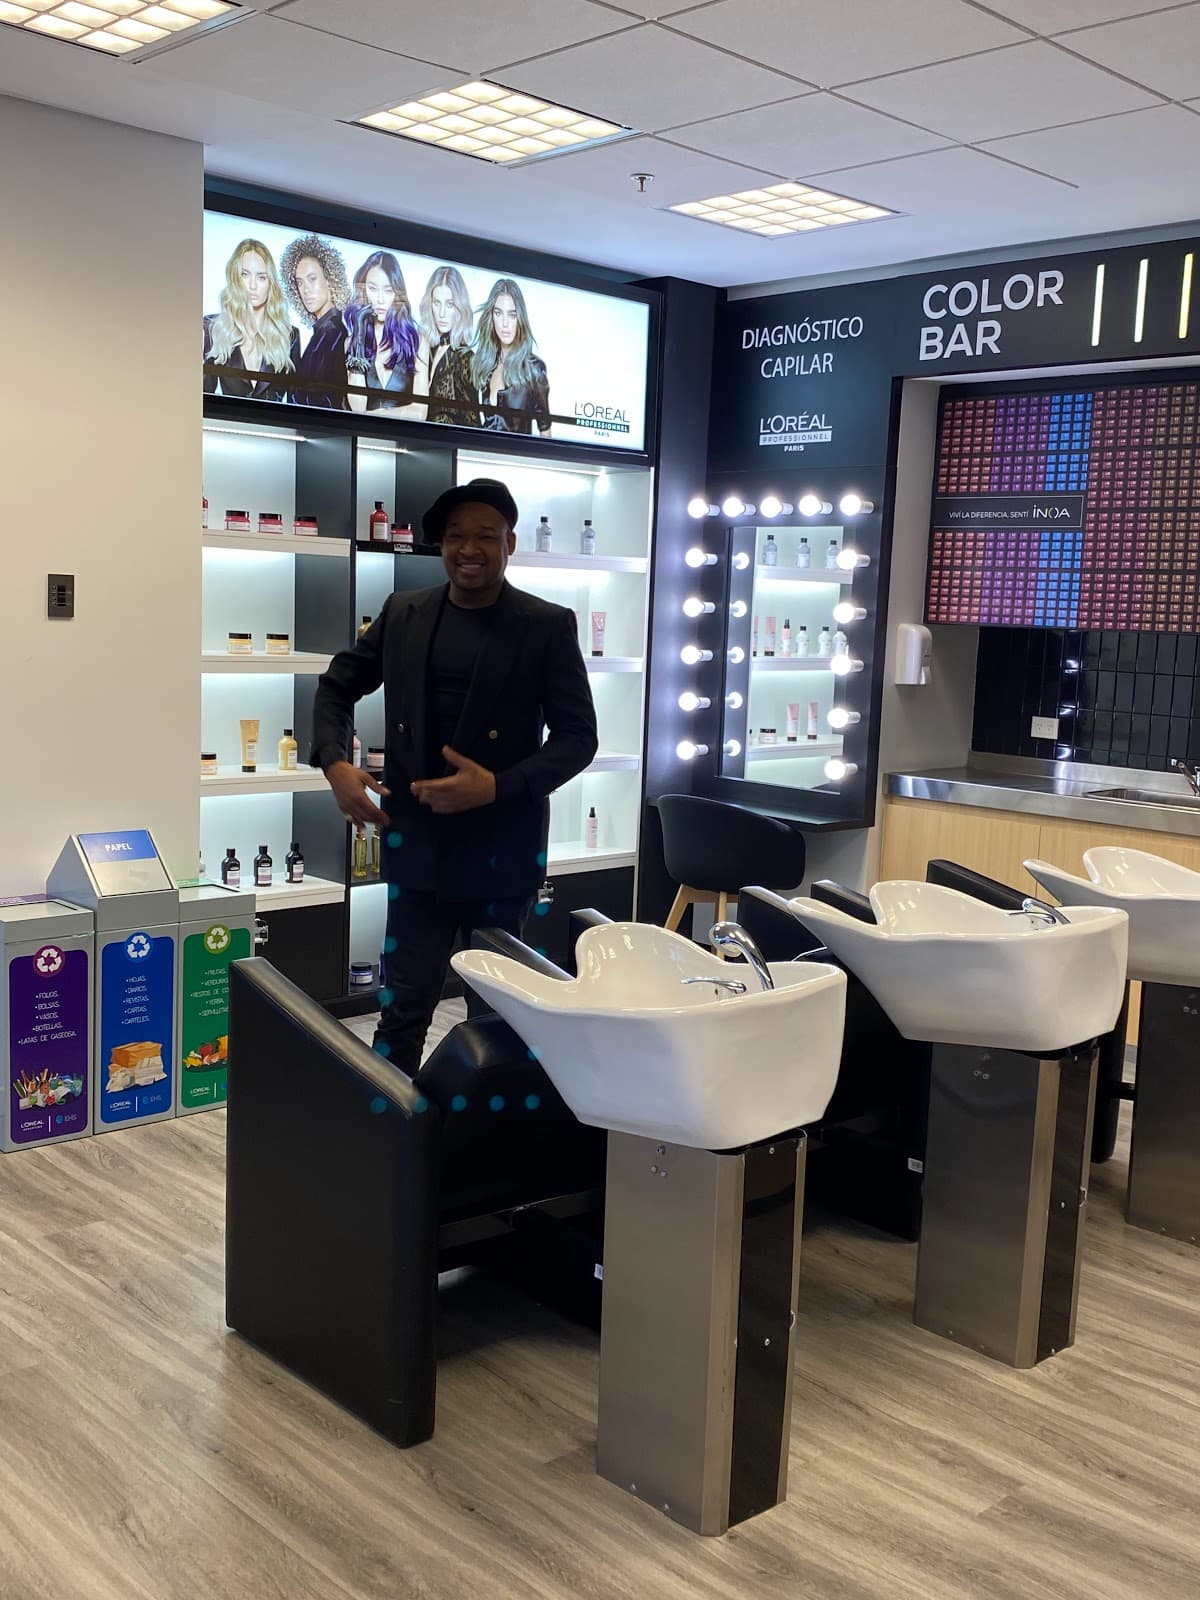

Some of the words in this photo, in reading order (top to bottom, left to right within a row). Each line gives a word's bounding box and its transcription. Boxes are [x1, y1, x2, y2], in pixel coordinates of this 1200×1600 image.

[922, 270, 1064, 320] COLOR
[742, 316, 863, 350] DIAGNÓSTICO
[919, 319, 1002, 361] BAR
[760, 352, 834, 378] CAPILAR
[576, 418, 629, 433] PROFESSIONNEL
[760, 411, 833, 434] L'ORÉAL
[761, 432, 830, 444] PROFESSIONNEL
[105, 843, 133, 851] PAPEL
